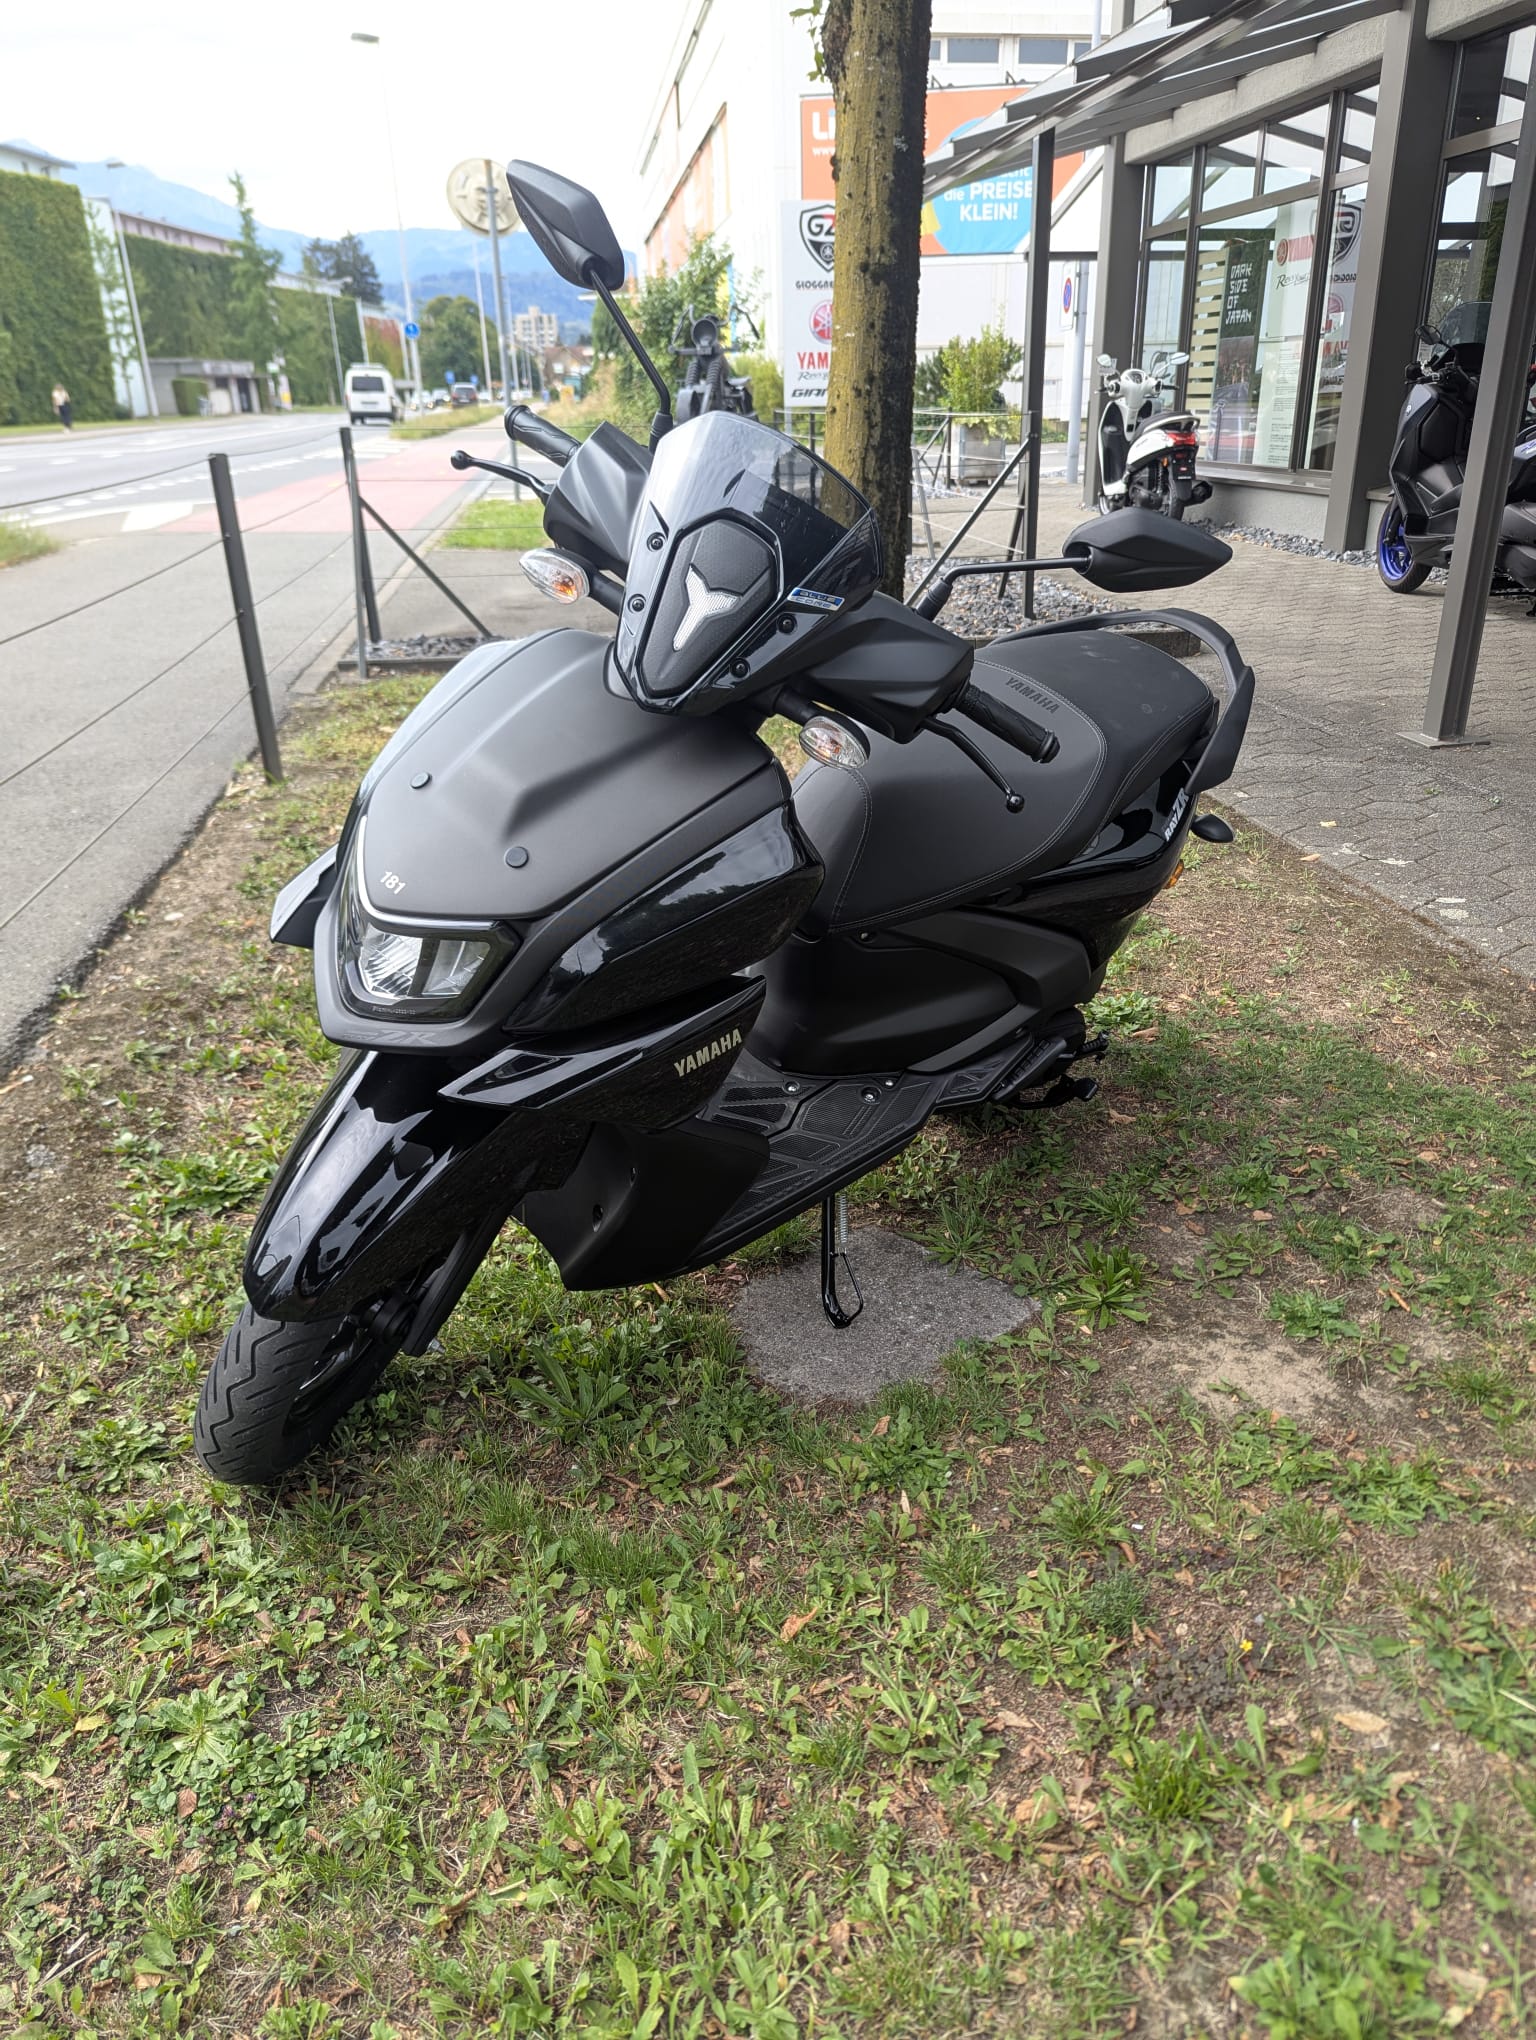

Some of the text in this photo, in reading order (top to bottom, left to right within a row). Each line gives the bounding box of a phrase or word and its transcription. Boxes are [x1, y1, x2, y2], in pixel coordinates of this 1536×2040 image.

[969, 181, 1032, 200] PREISE
[960, 203, 1018, 222] KLEIN!
[1231, 263, 1252, 279] DARK
[1230, 278, 1248, 294] SIDE
[1227, 295, 1240, 309] OF
[1225, 309, 1252, 325] JAPAN
[1006, 677, 1060, 713] YAMAHA
[380, 871, 406, 894] 181
[674, 1028, 742, 1077] YAMAHA
